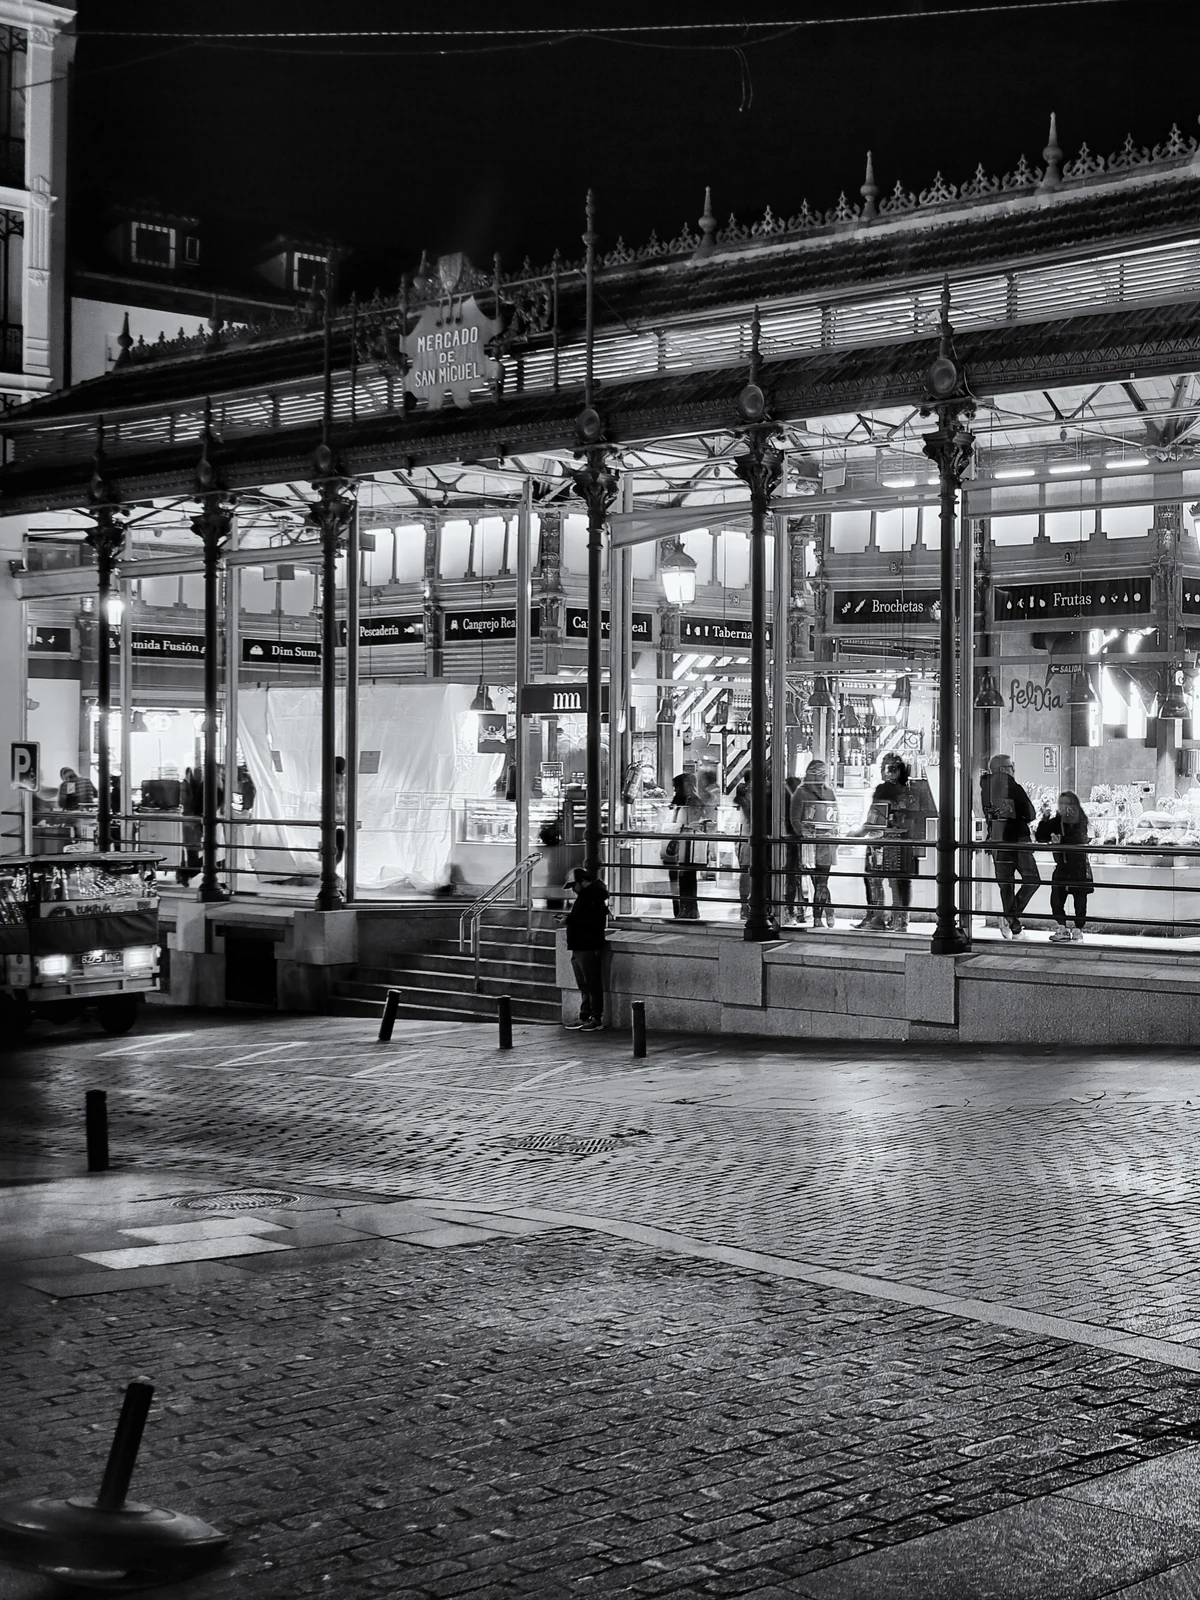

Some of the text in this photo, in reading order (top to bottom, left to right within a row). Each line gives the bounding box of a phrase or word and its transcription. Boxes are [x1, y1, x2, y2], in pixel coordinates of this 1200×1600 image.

[417, 326, 478, 353] MERCADO
[439, 350, 455, 364] DE
[415, 370, 436, 388] SAN
[871, 599, 924, 613] Brochetas
[1052, 592, 1092, 607] Frutas
[359, 624, 400, 637] Pescadería
[462, 616, 517, 633] Cangrejo Rea
[712, 625, 753, 640] Taberna
[162, 640, 199, 652] Fusión
[271, 645, 317, 657] Dim Sum
[1059, 664, 1082, 673] SALIDA
[15, 748, 31, 781] P
